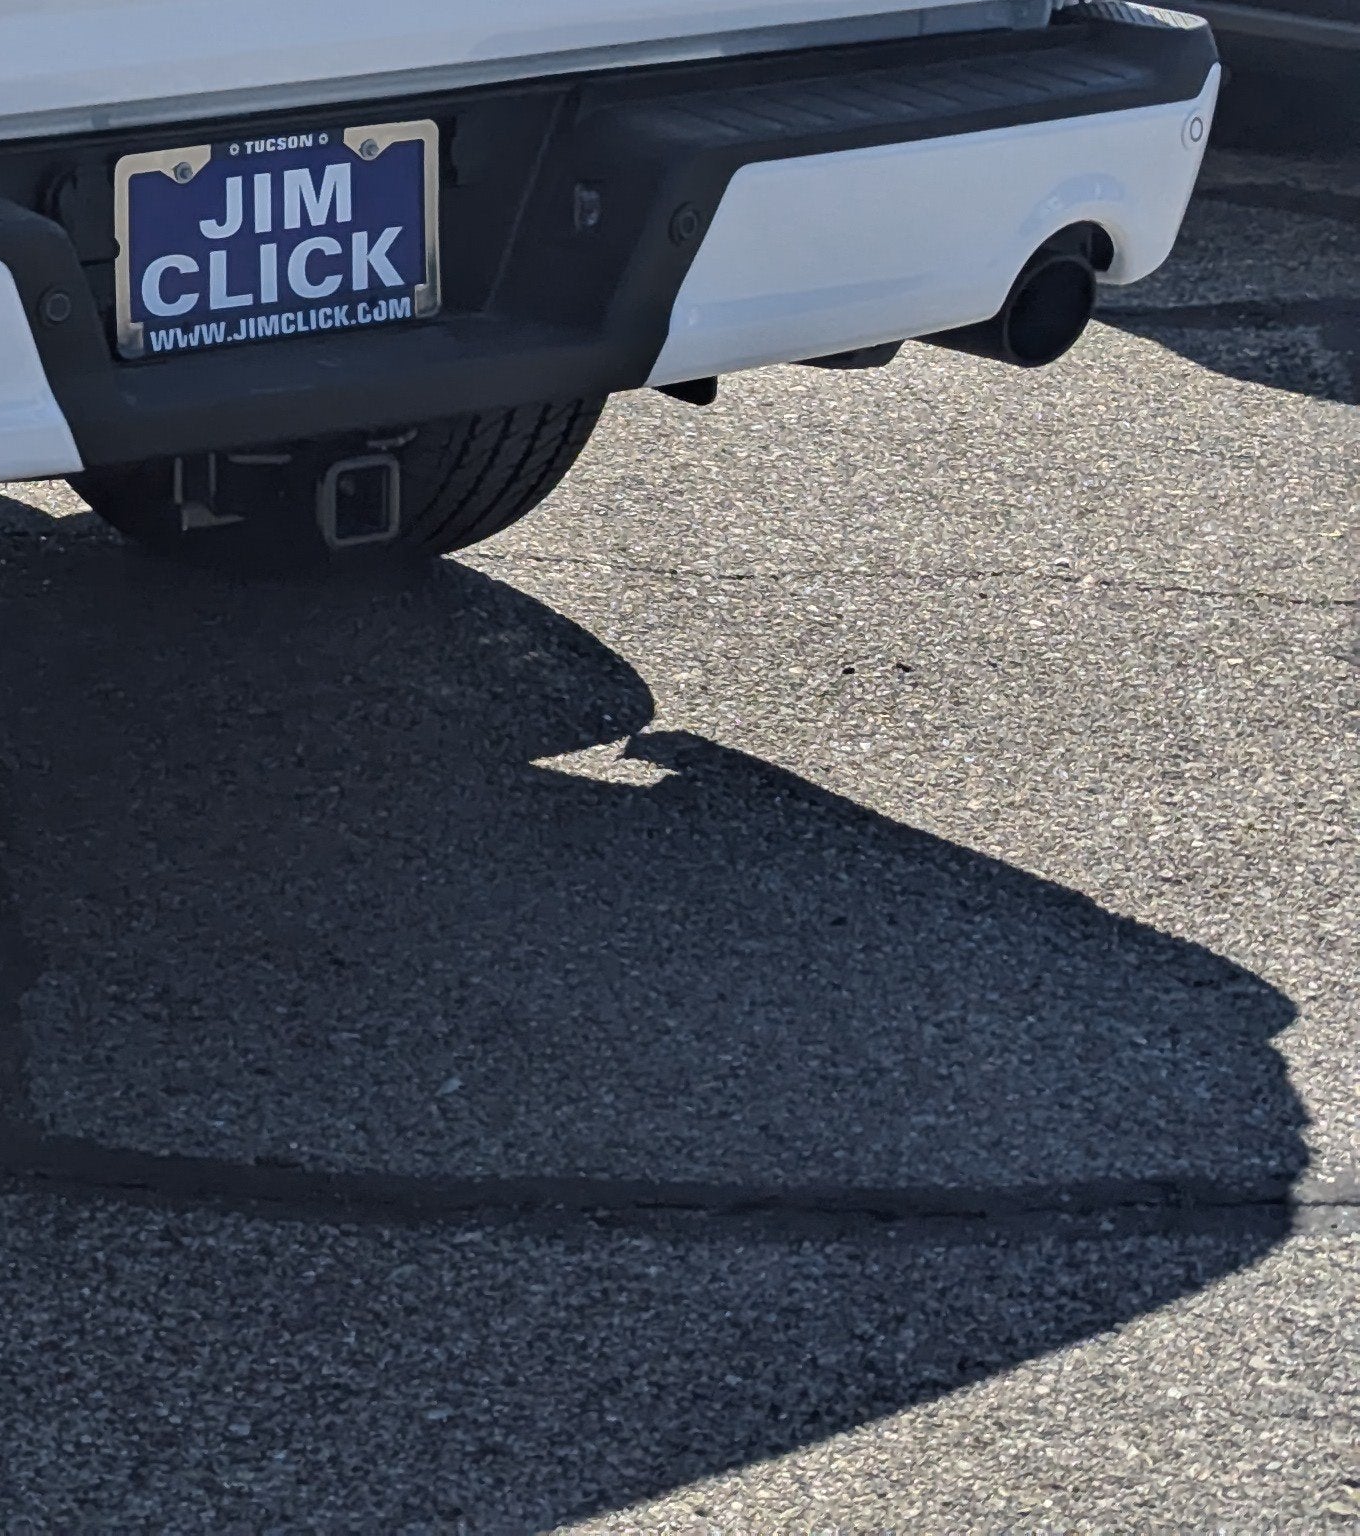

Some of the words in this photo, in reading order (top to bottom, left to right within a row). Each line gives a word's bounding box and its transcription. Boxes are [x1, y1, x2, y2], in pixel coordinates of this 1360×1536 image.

[244, 134, 313, 154] TUCSON
[199, 162, 352, 239] JIM
[141, 226, 405, 317] CLICK
[149, 296, 412, 352] WWW.JIMCLICK.COM
